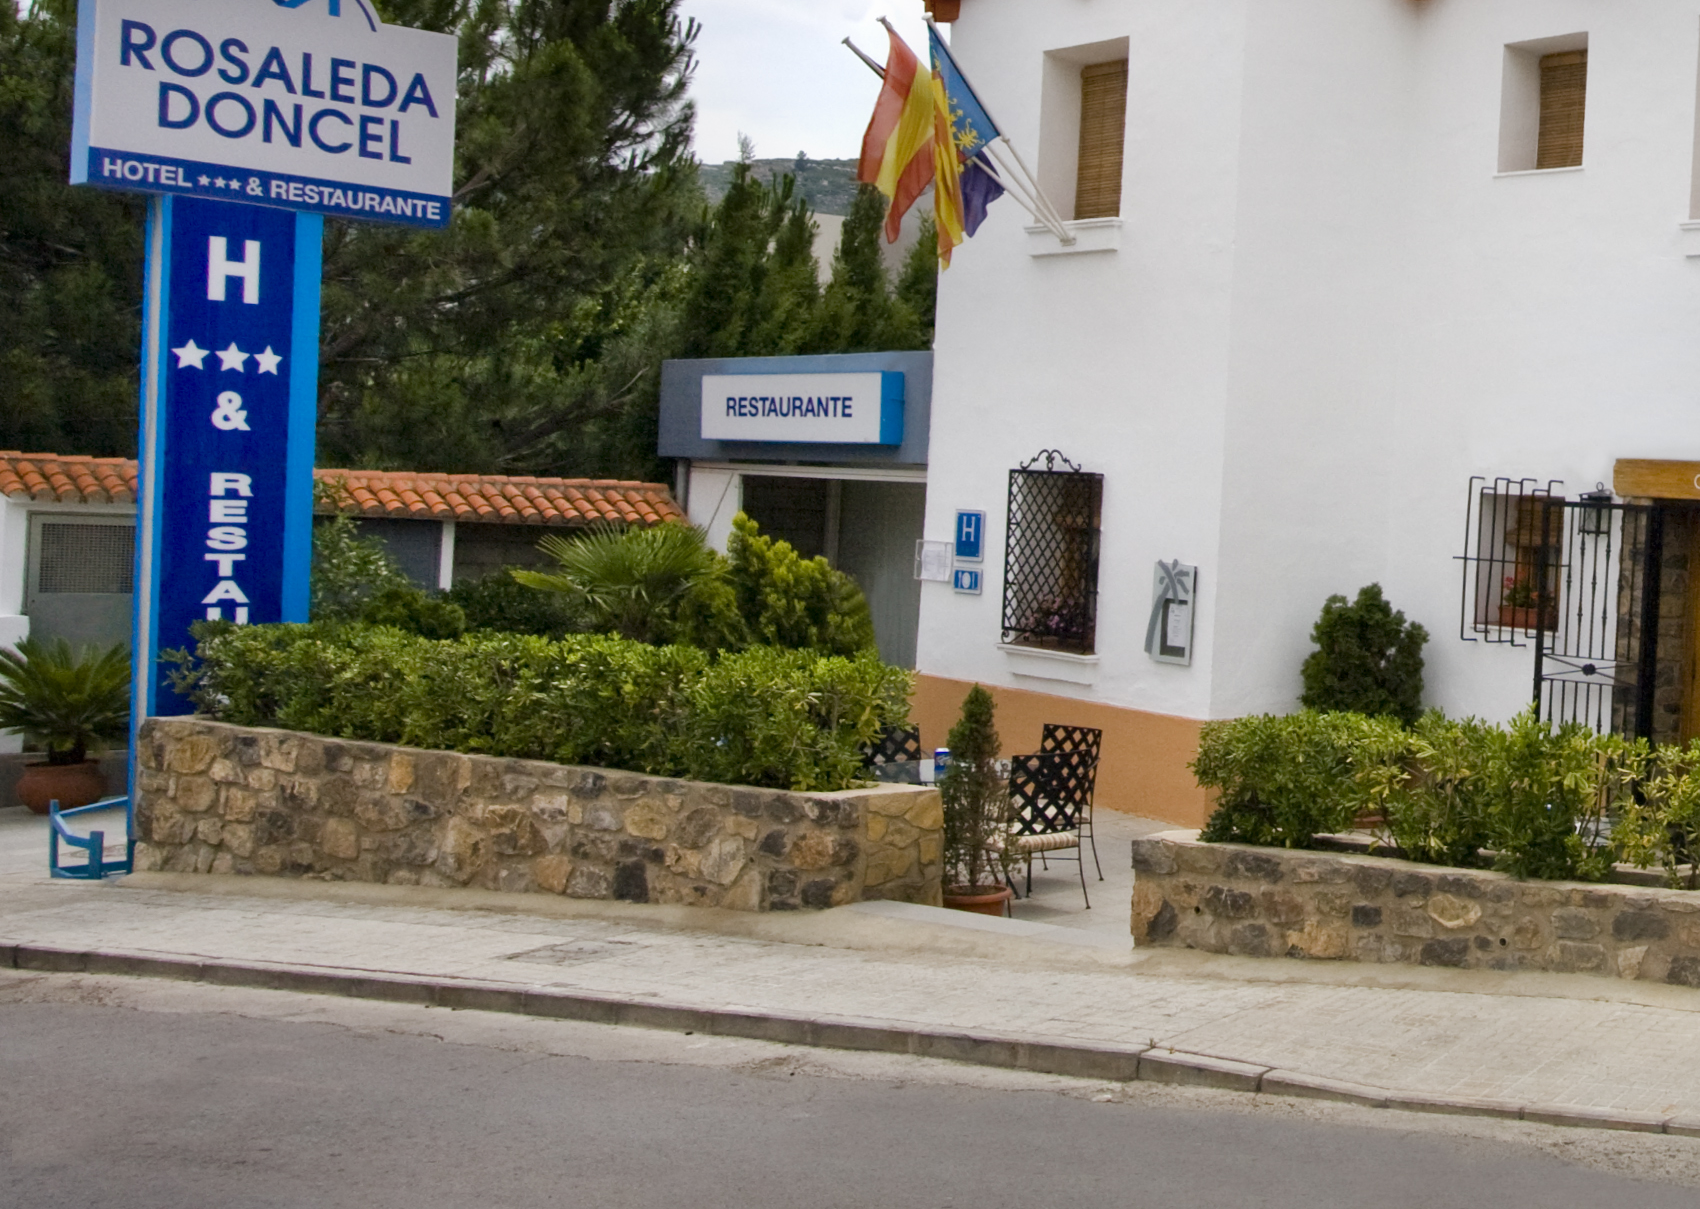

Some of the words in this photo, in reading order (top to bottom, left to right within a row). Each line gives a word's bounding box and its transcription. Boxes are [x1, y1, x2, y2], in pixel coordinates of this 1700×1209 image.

[119, 18, 440, 119] ROSALEDA
[157, 80, 412, 165] DONCEL
[102, 156, 193, 188] HOTEL
[245, 176, 264, 197] &
[269, 178, 442, 221] RESTAURANTE
[206, 235, 261, 305] H
[210, 390, 251, 431] &
[726, 395, 854, 419] RESTAURANTE
[201, 472, 254, 626] RESTAU
[961, 515, 976, 542] H
